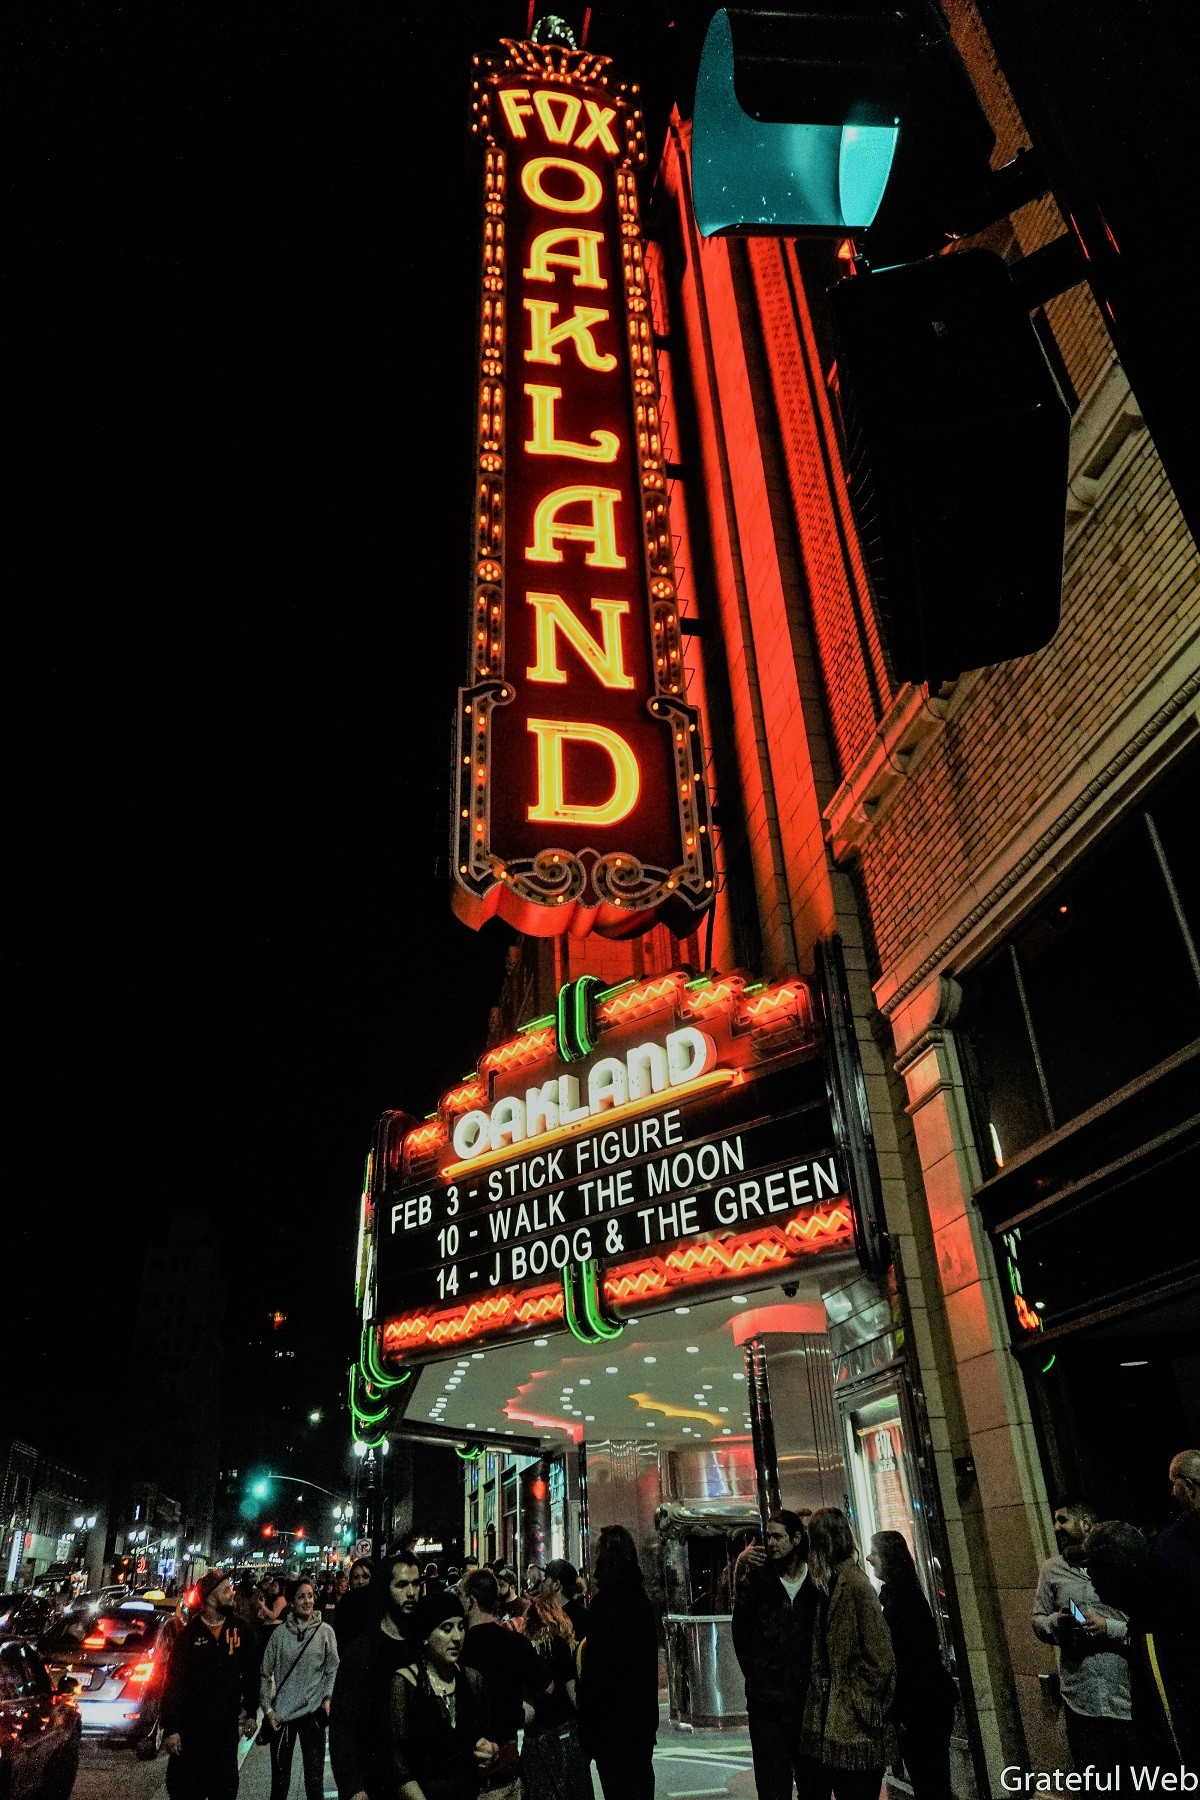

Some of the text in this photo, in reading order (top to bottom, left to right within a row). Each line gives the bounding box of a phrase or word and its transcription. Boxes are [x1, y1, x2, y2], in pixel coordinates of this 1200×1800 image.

[498, 88, 620, 155] FOX
[520, 156, 641, 828] OAKLAND
[453, 1026, 716, 1160] OAKLAND
[391, 1194, 432, 1235] FEB
[446, 1185, 459, 1216] 3
[488, 1148, 565, 1203] STICK
[576, 1109, 683, 1175] FIGURE
[436, 1264, 460, 1300] 14
[489, 1252, 501, 1286] J
[511, 1227, 593, 1281] BOOG
[605, 1218, 625, 1254] &
[637, 1196, 700, 1244] THE
[714, 1157, 839, 1225] GREEN
[437, 1224, 459, 1259] 10
[488, 1190, 566, 1243] WALK
[577, 1169, 635, 1216] THE
[646, 1135, 745, 1197] MOON
